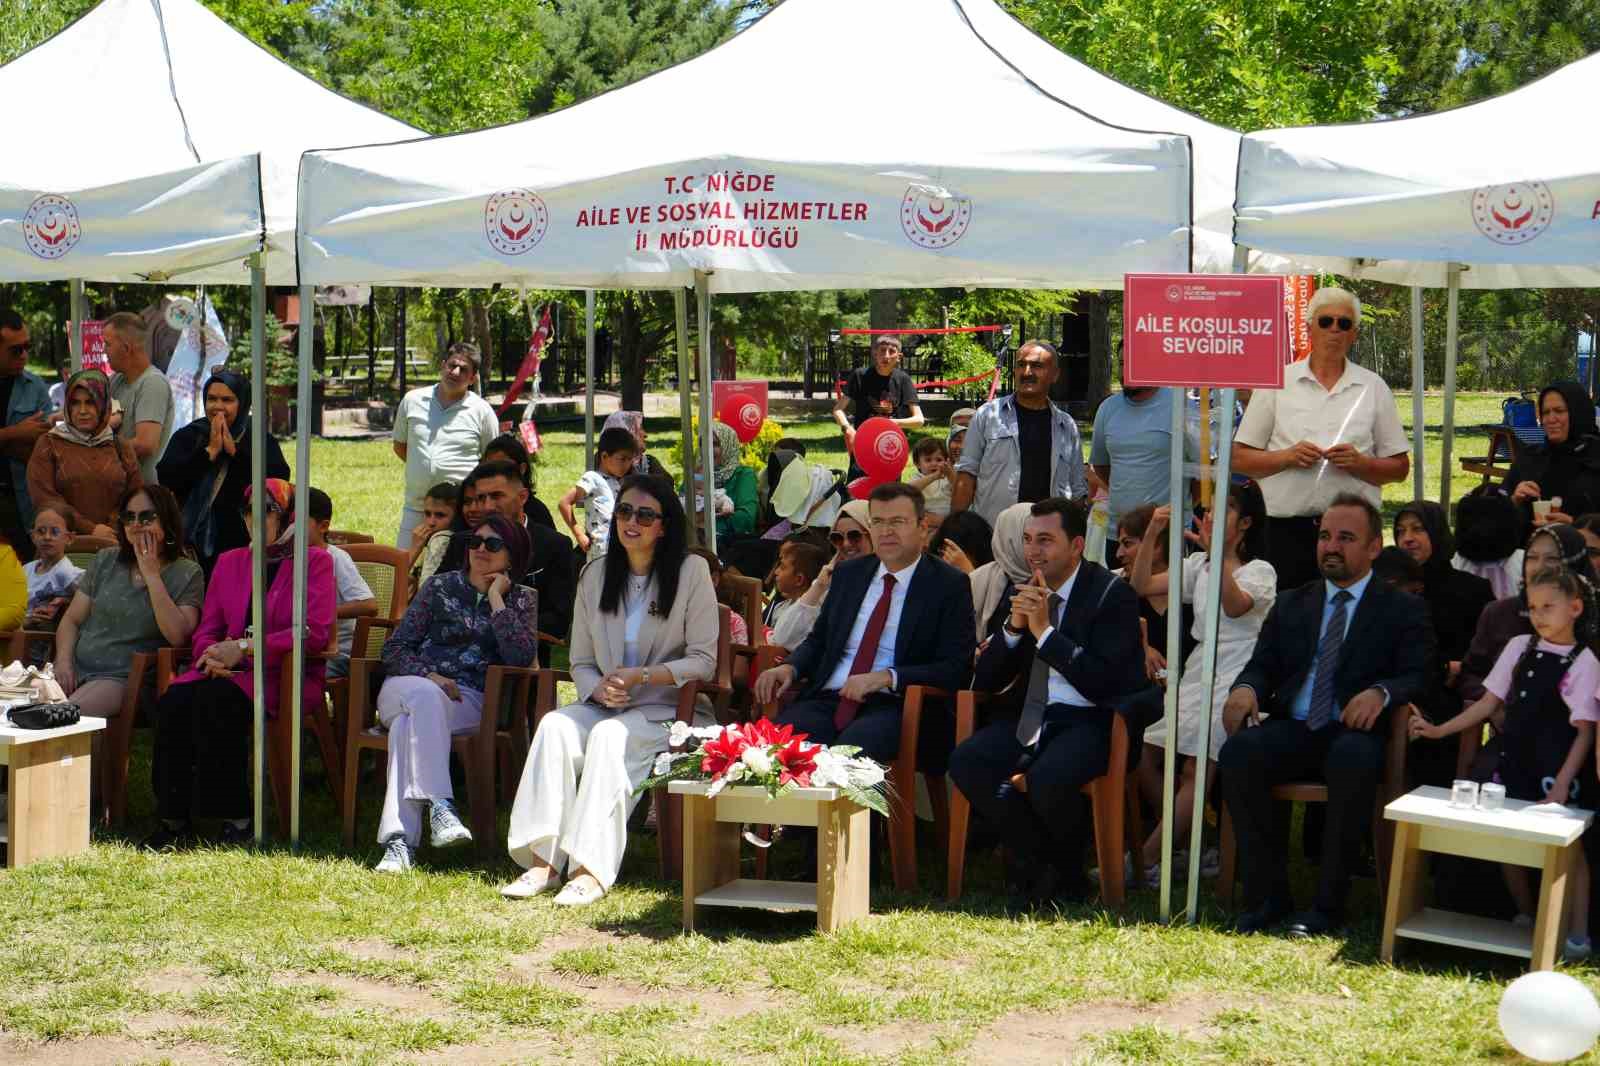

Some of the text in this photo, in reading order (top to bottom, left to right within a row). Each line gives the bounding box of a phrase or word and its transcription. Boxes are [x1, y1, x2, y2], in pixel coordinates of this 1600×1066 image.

[707, 170, 776, 192] NİĞDE
[576, 198, 868, 227] AİLE VE SOSYAL HİZMETLER
[660, 225, 799, 250] MÜDÜRLÜĞÜ
[1135, 313, 1273, 338] AİLE KOŞULSUZ
[1163, 335, 1245, 355] SEVGİDİR
